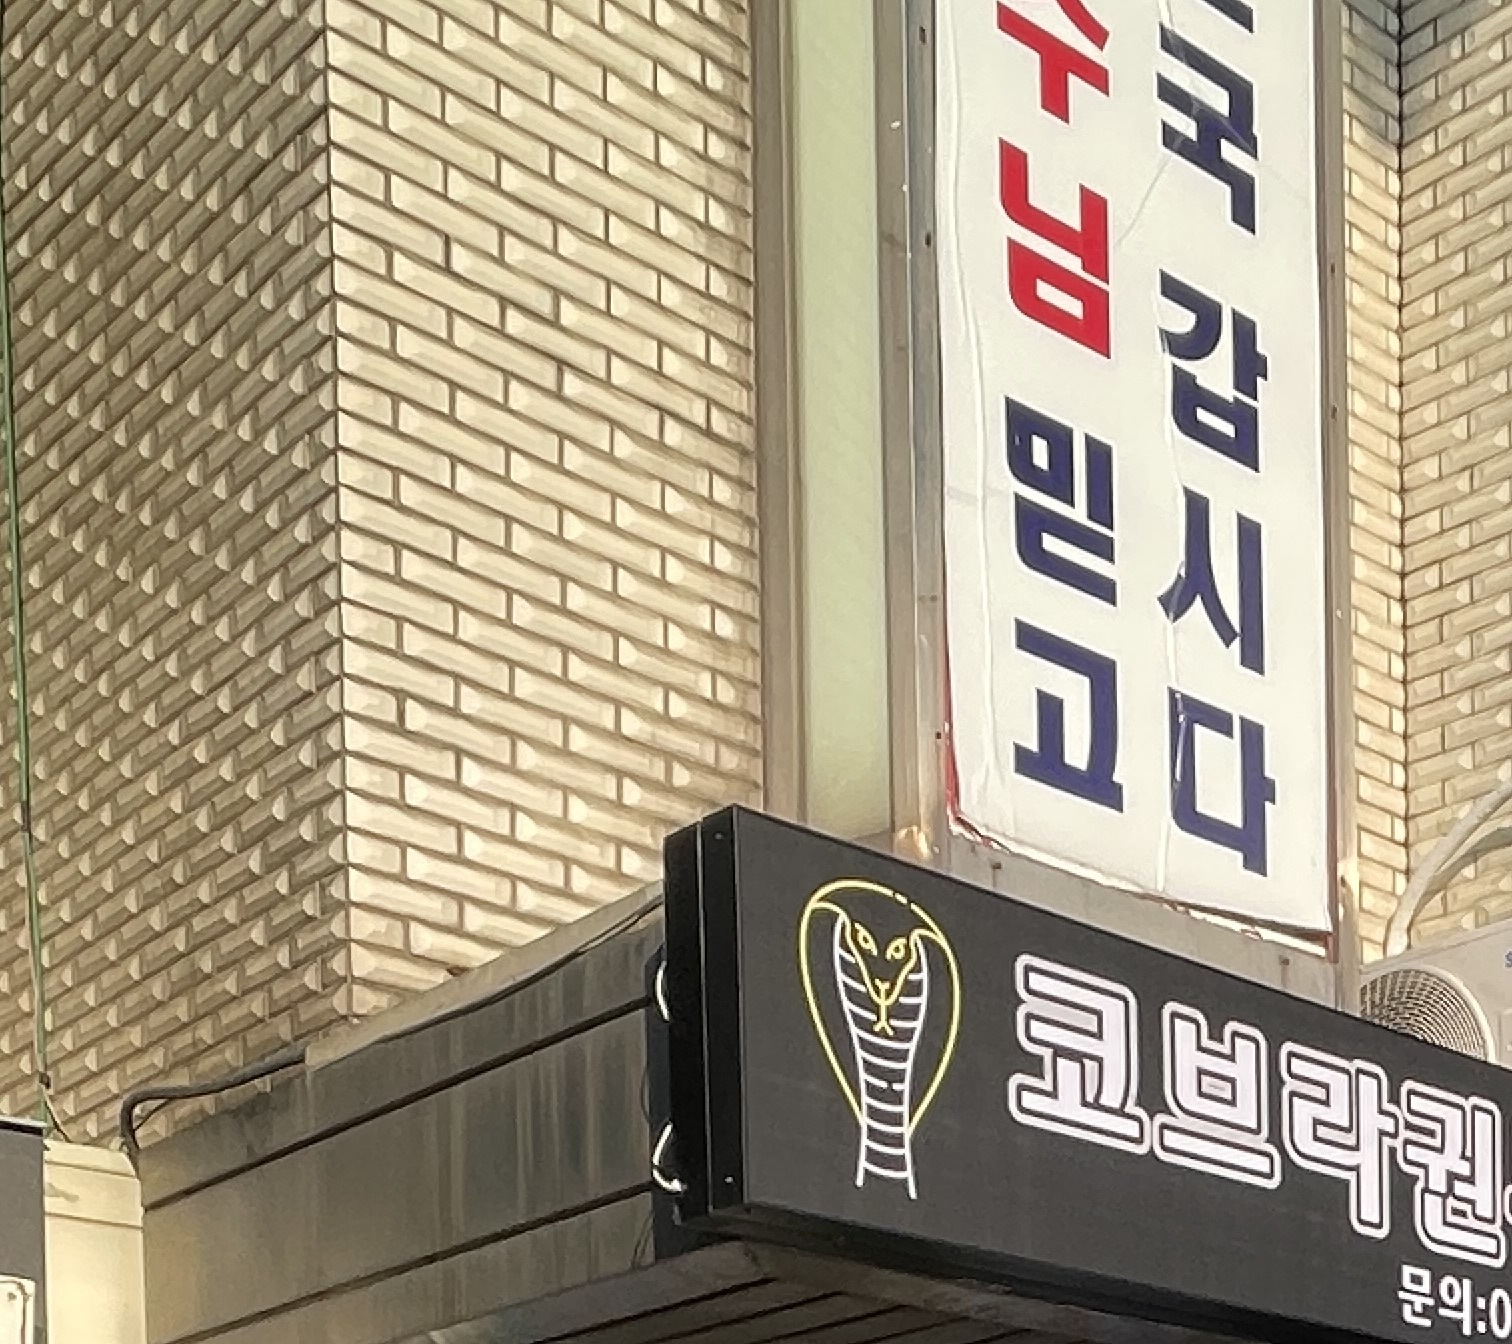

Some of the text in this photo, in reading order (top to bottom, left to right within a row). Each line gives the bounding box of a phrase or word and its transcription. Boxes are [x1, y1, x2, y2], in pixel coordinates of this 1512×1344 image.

[1003, 394, 1125, 813] 믿고
[1156, 0, 1277, 878] 국 갑시다
